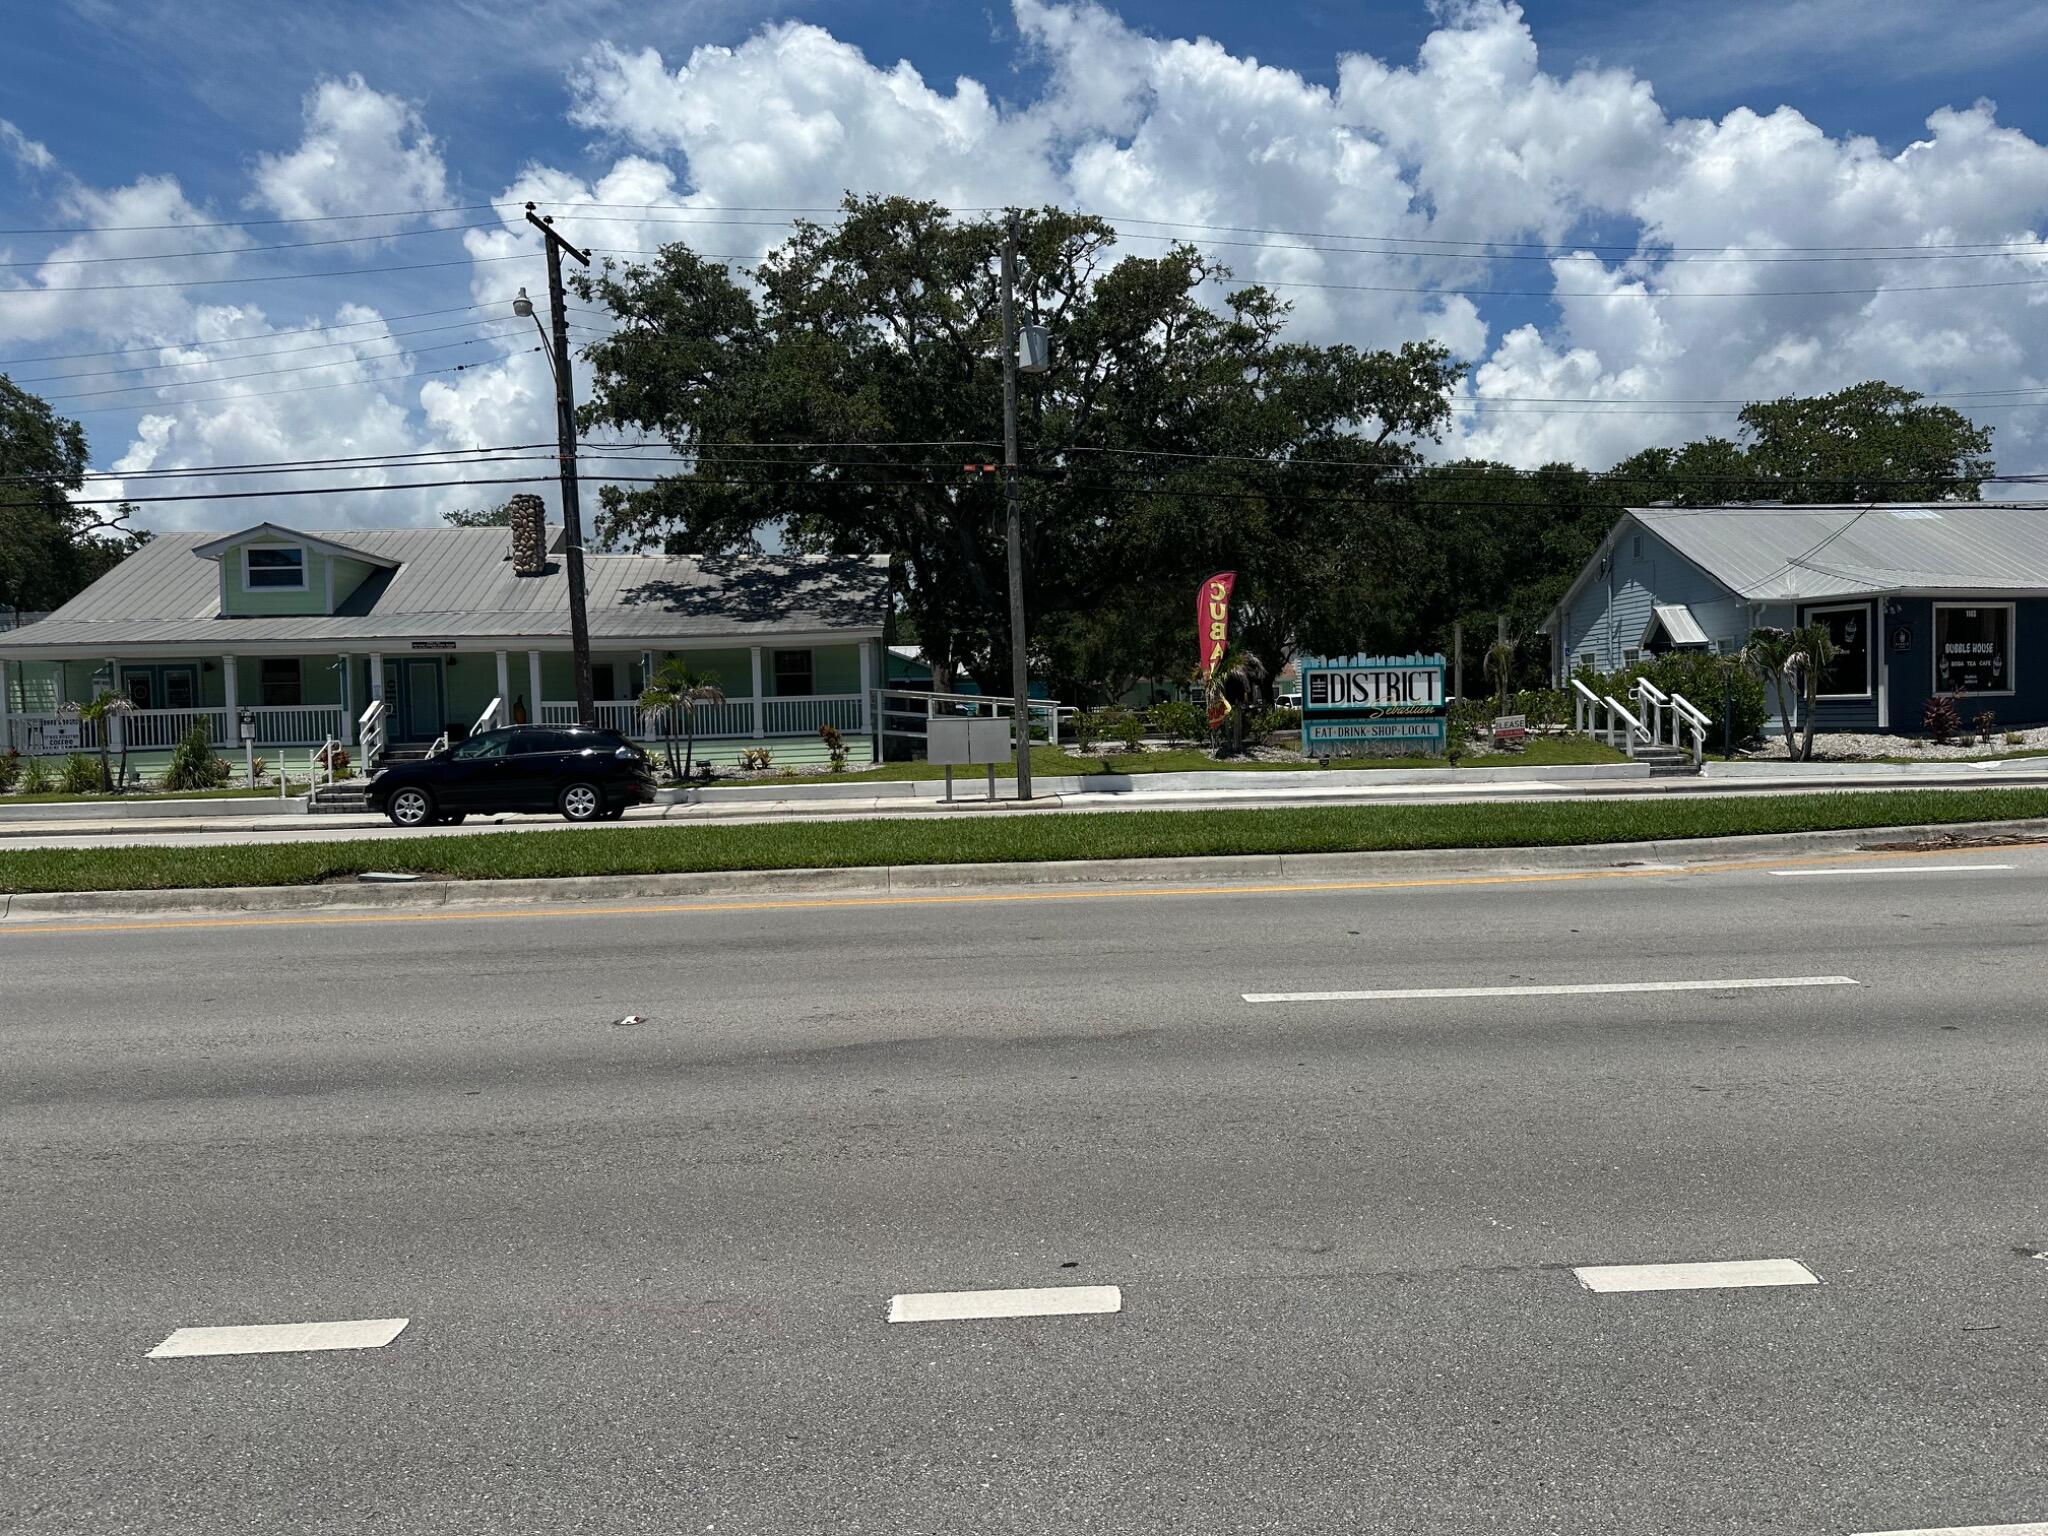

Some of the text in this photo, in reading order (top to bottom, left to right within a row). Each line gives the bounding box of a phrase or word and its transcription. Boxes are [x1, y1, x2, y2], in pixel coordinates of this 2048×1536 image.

[1944, 643, 1994, 653] BUBBLE HOUSE
[1311, 671, 1438, 703] THE DISTRICT
[1369, 696, 1435, 719] Sebastian
[1499, 720, 1525, 728] LEASE
[1315, 725, 1433, 738] EAT DRINK SHOP LOCAL
